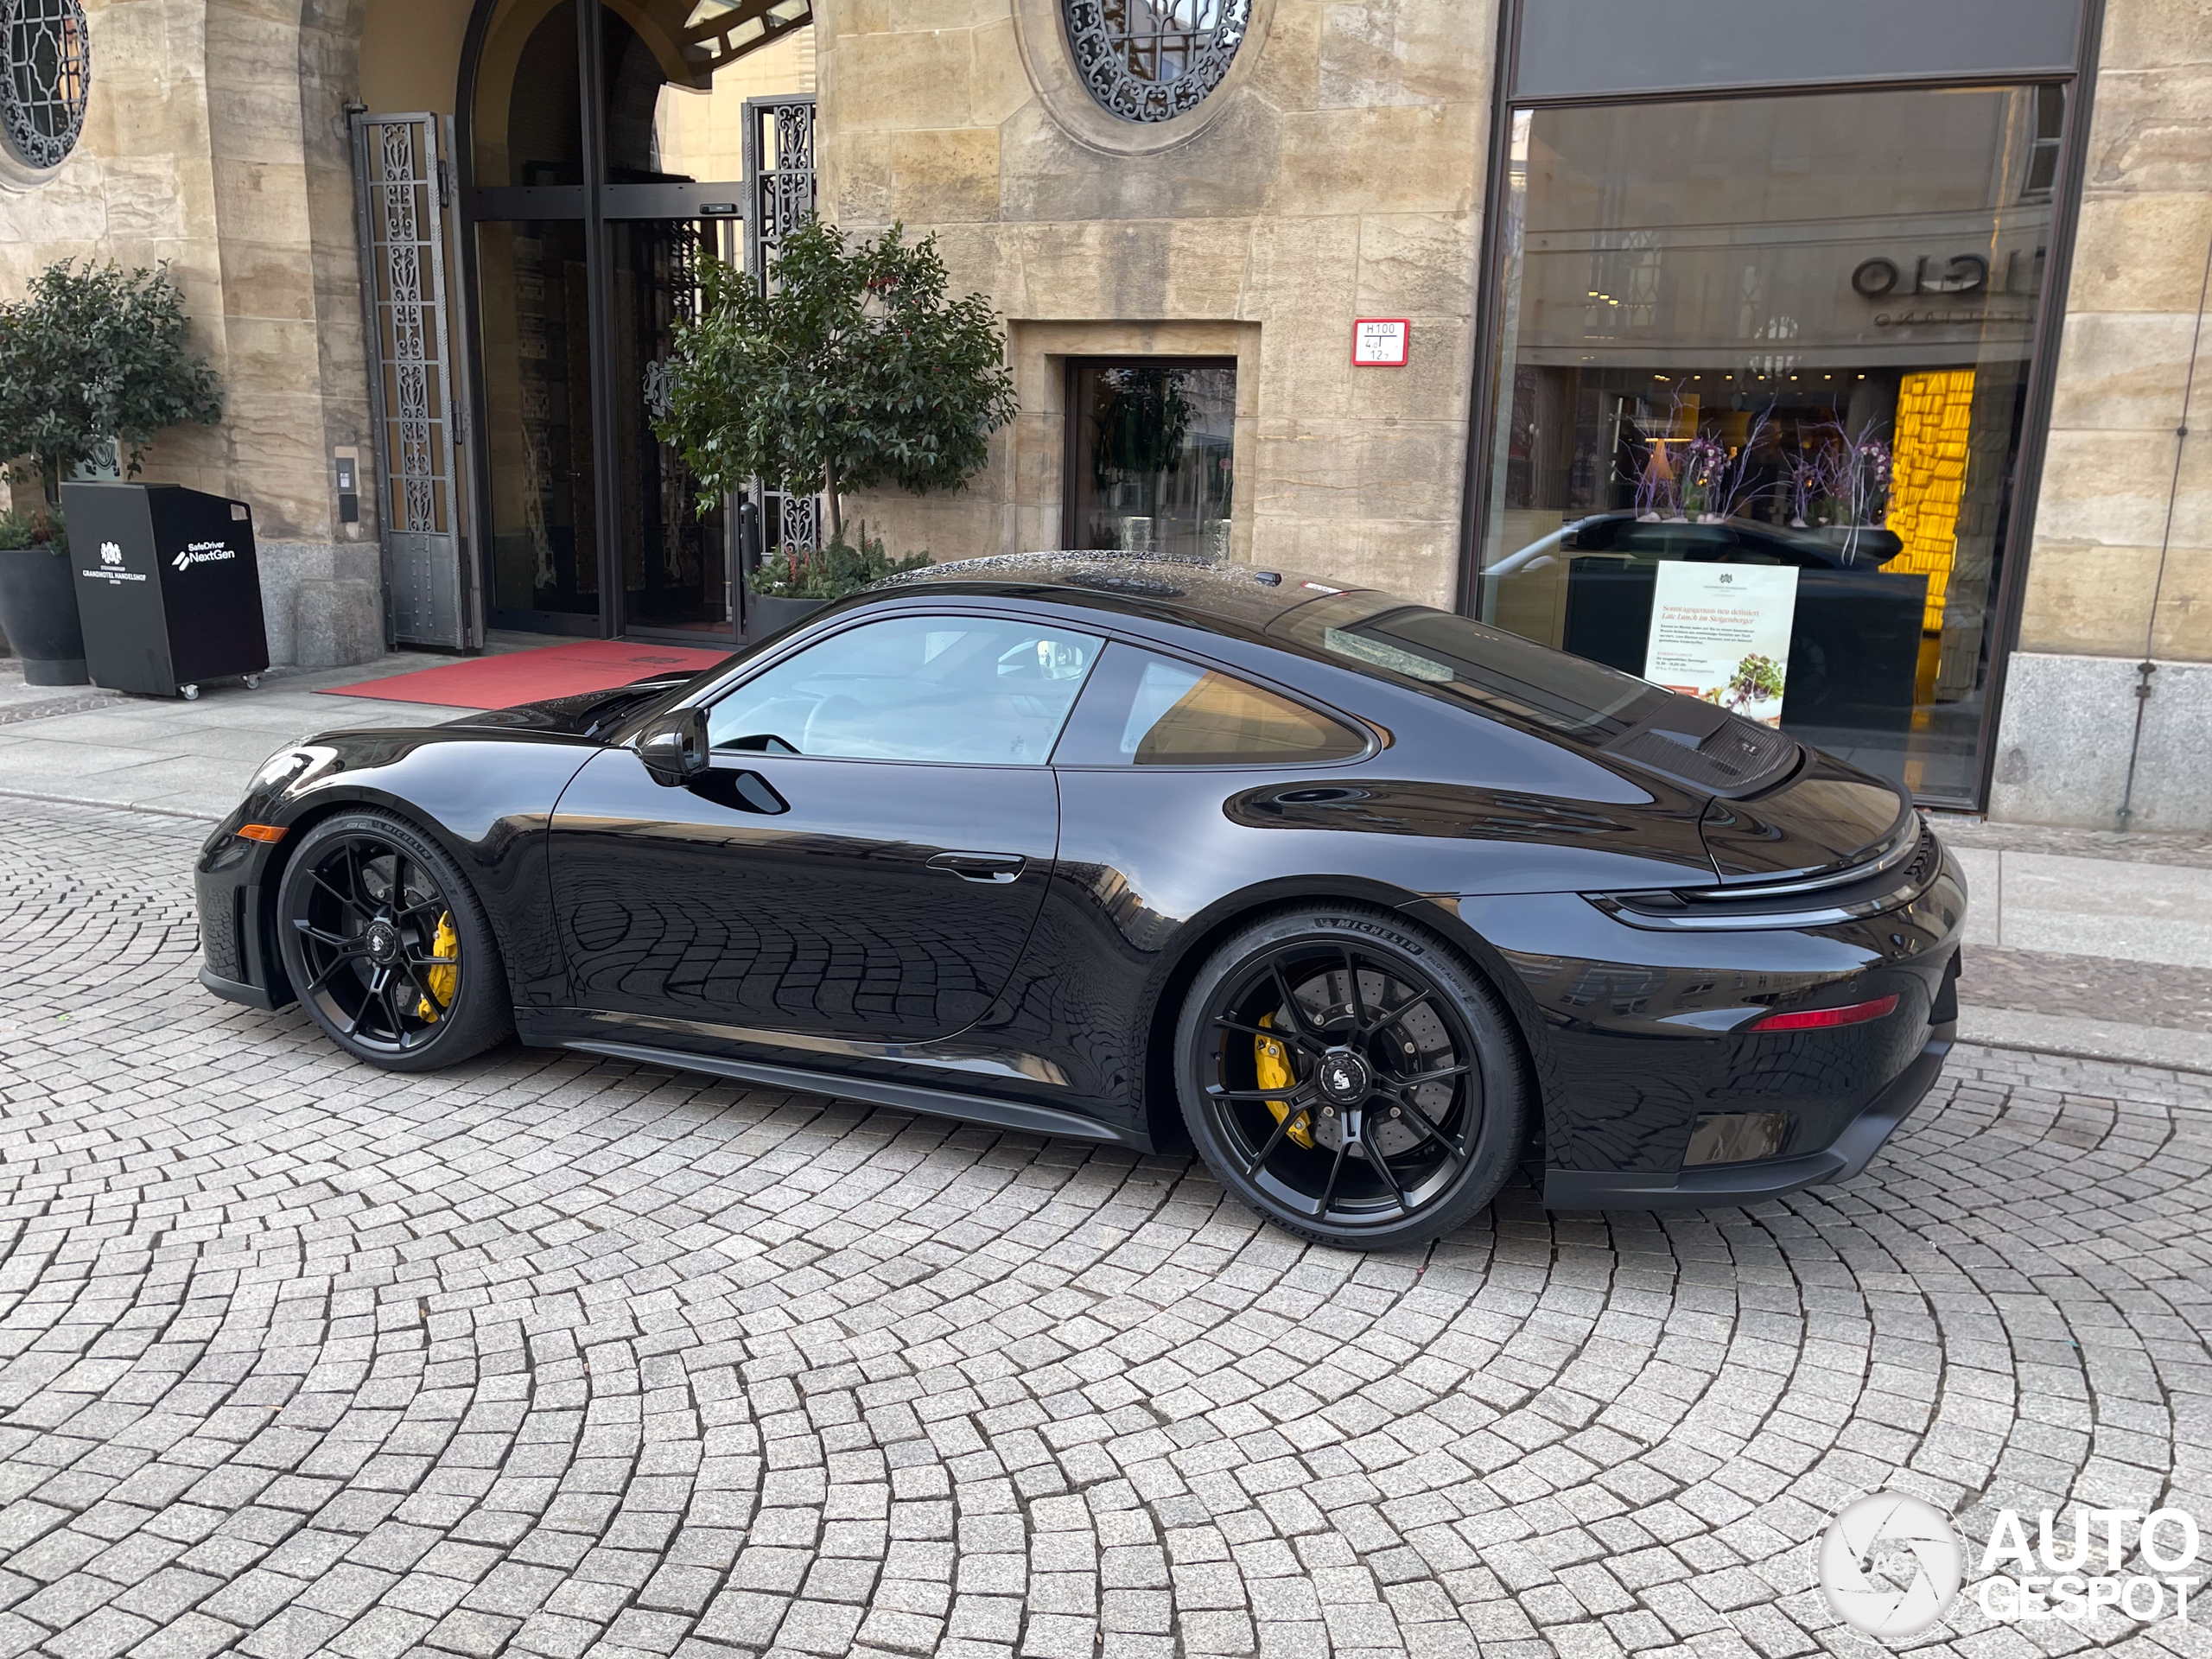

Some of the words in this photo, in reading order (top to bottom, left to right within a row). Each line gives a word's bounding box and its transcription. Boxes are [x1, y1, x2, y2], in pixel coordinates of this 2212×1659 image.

[188, 541, 225, 552] SafeDriver
[189, 550, 235, 563] NextGen
[82, 569, 115, 579] GRANDHOTEL
[1662, 604, 1716, 615] Sonntagsgenuss
[1731, 608, 1759, 617] definiert
[1709, 614, 1755, 625] Steigenberger
[384, 824, 430, 858] MICHELIN
[1336, 919, 1420, 952] MICHELIN
[1427, 956, 1446, 971] PILOT
[1445, 972, 1464, 990] ALPIN
